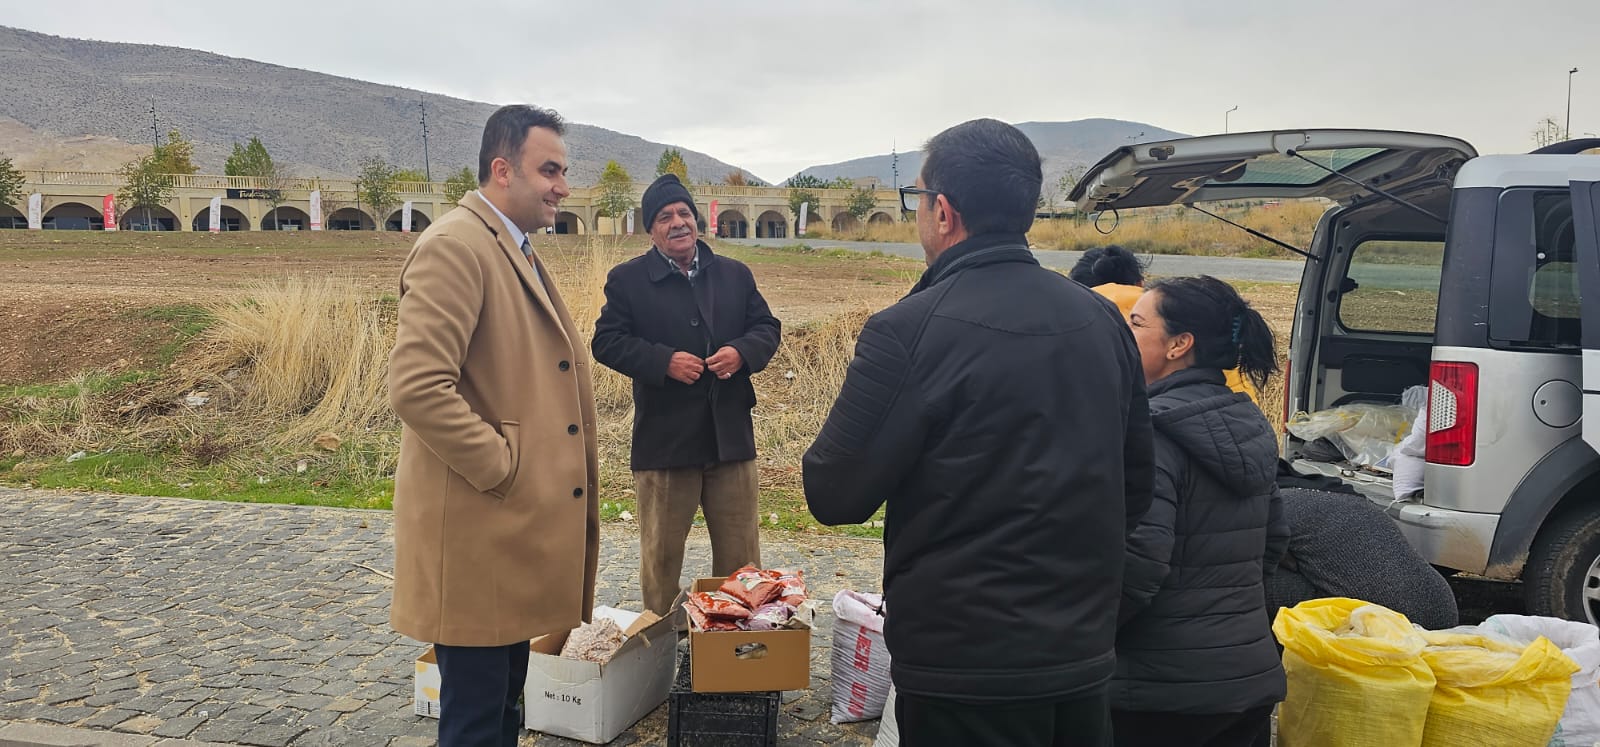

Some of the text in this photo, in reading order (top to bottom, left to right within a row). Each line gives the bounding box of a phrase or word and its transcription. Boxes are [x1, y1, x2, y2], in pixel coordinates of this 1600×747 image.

[545, 691, 555, 700] Net
[561, 694, 570, 702] 10
[572, 696, 581, 705] Kg
